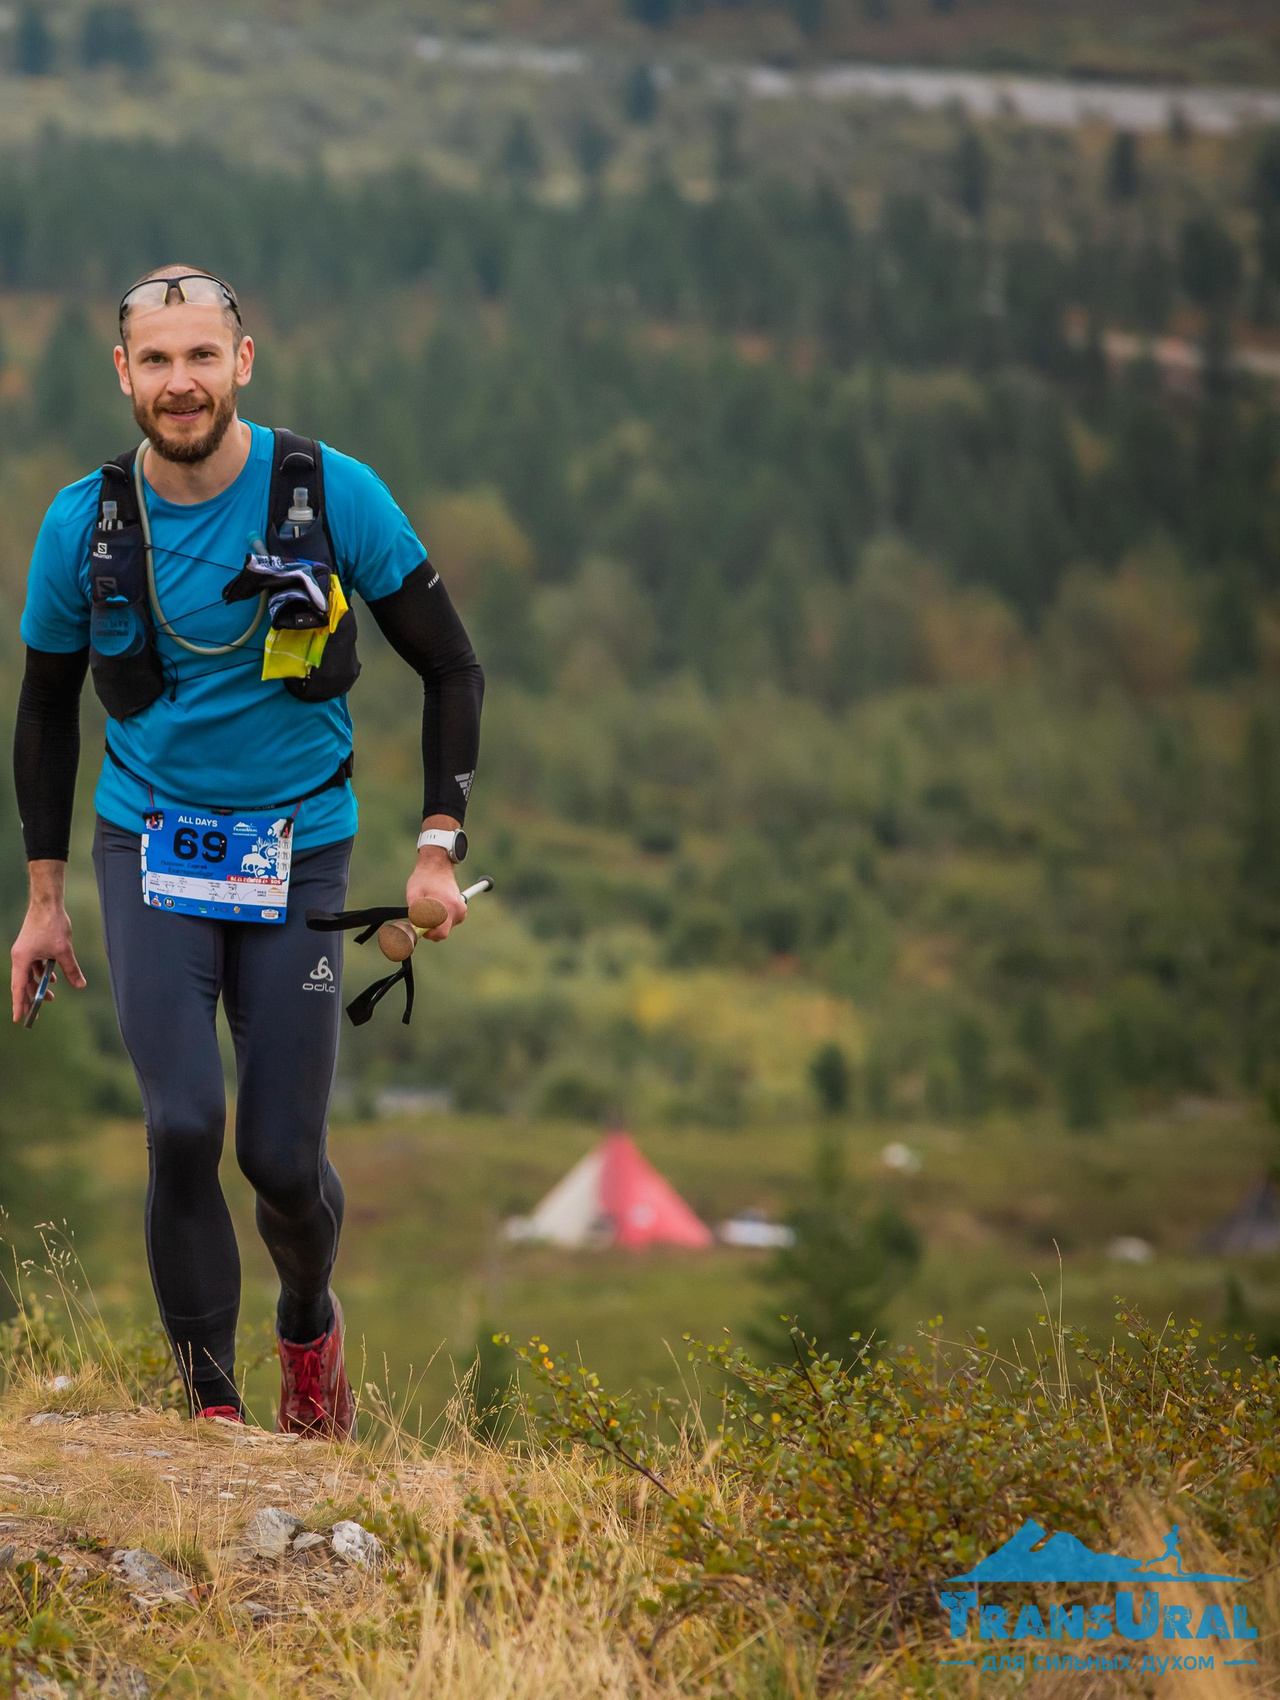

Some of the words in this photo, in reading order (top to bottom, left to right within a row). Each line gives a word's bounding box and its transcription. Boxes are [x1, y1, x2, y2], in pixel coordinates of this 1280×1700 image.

[178, 815, 194, 825] ALL
[195, 817, 219, 828] DAYS
[173, 827, 228, 864] 69
[302, 982, 336, 994] odlo
